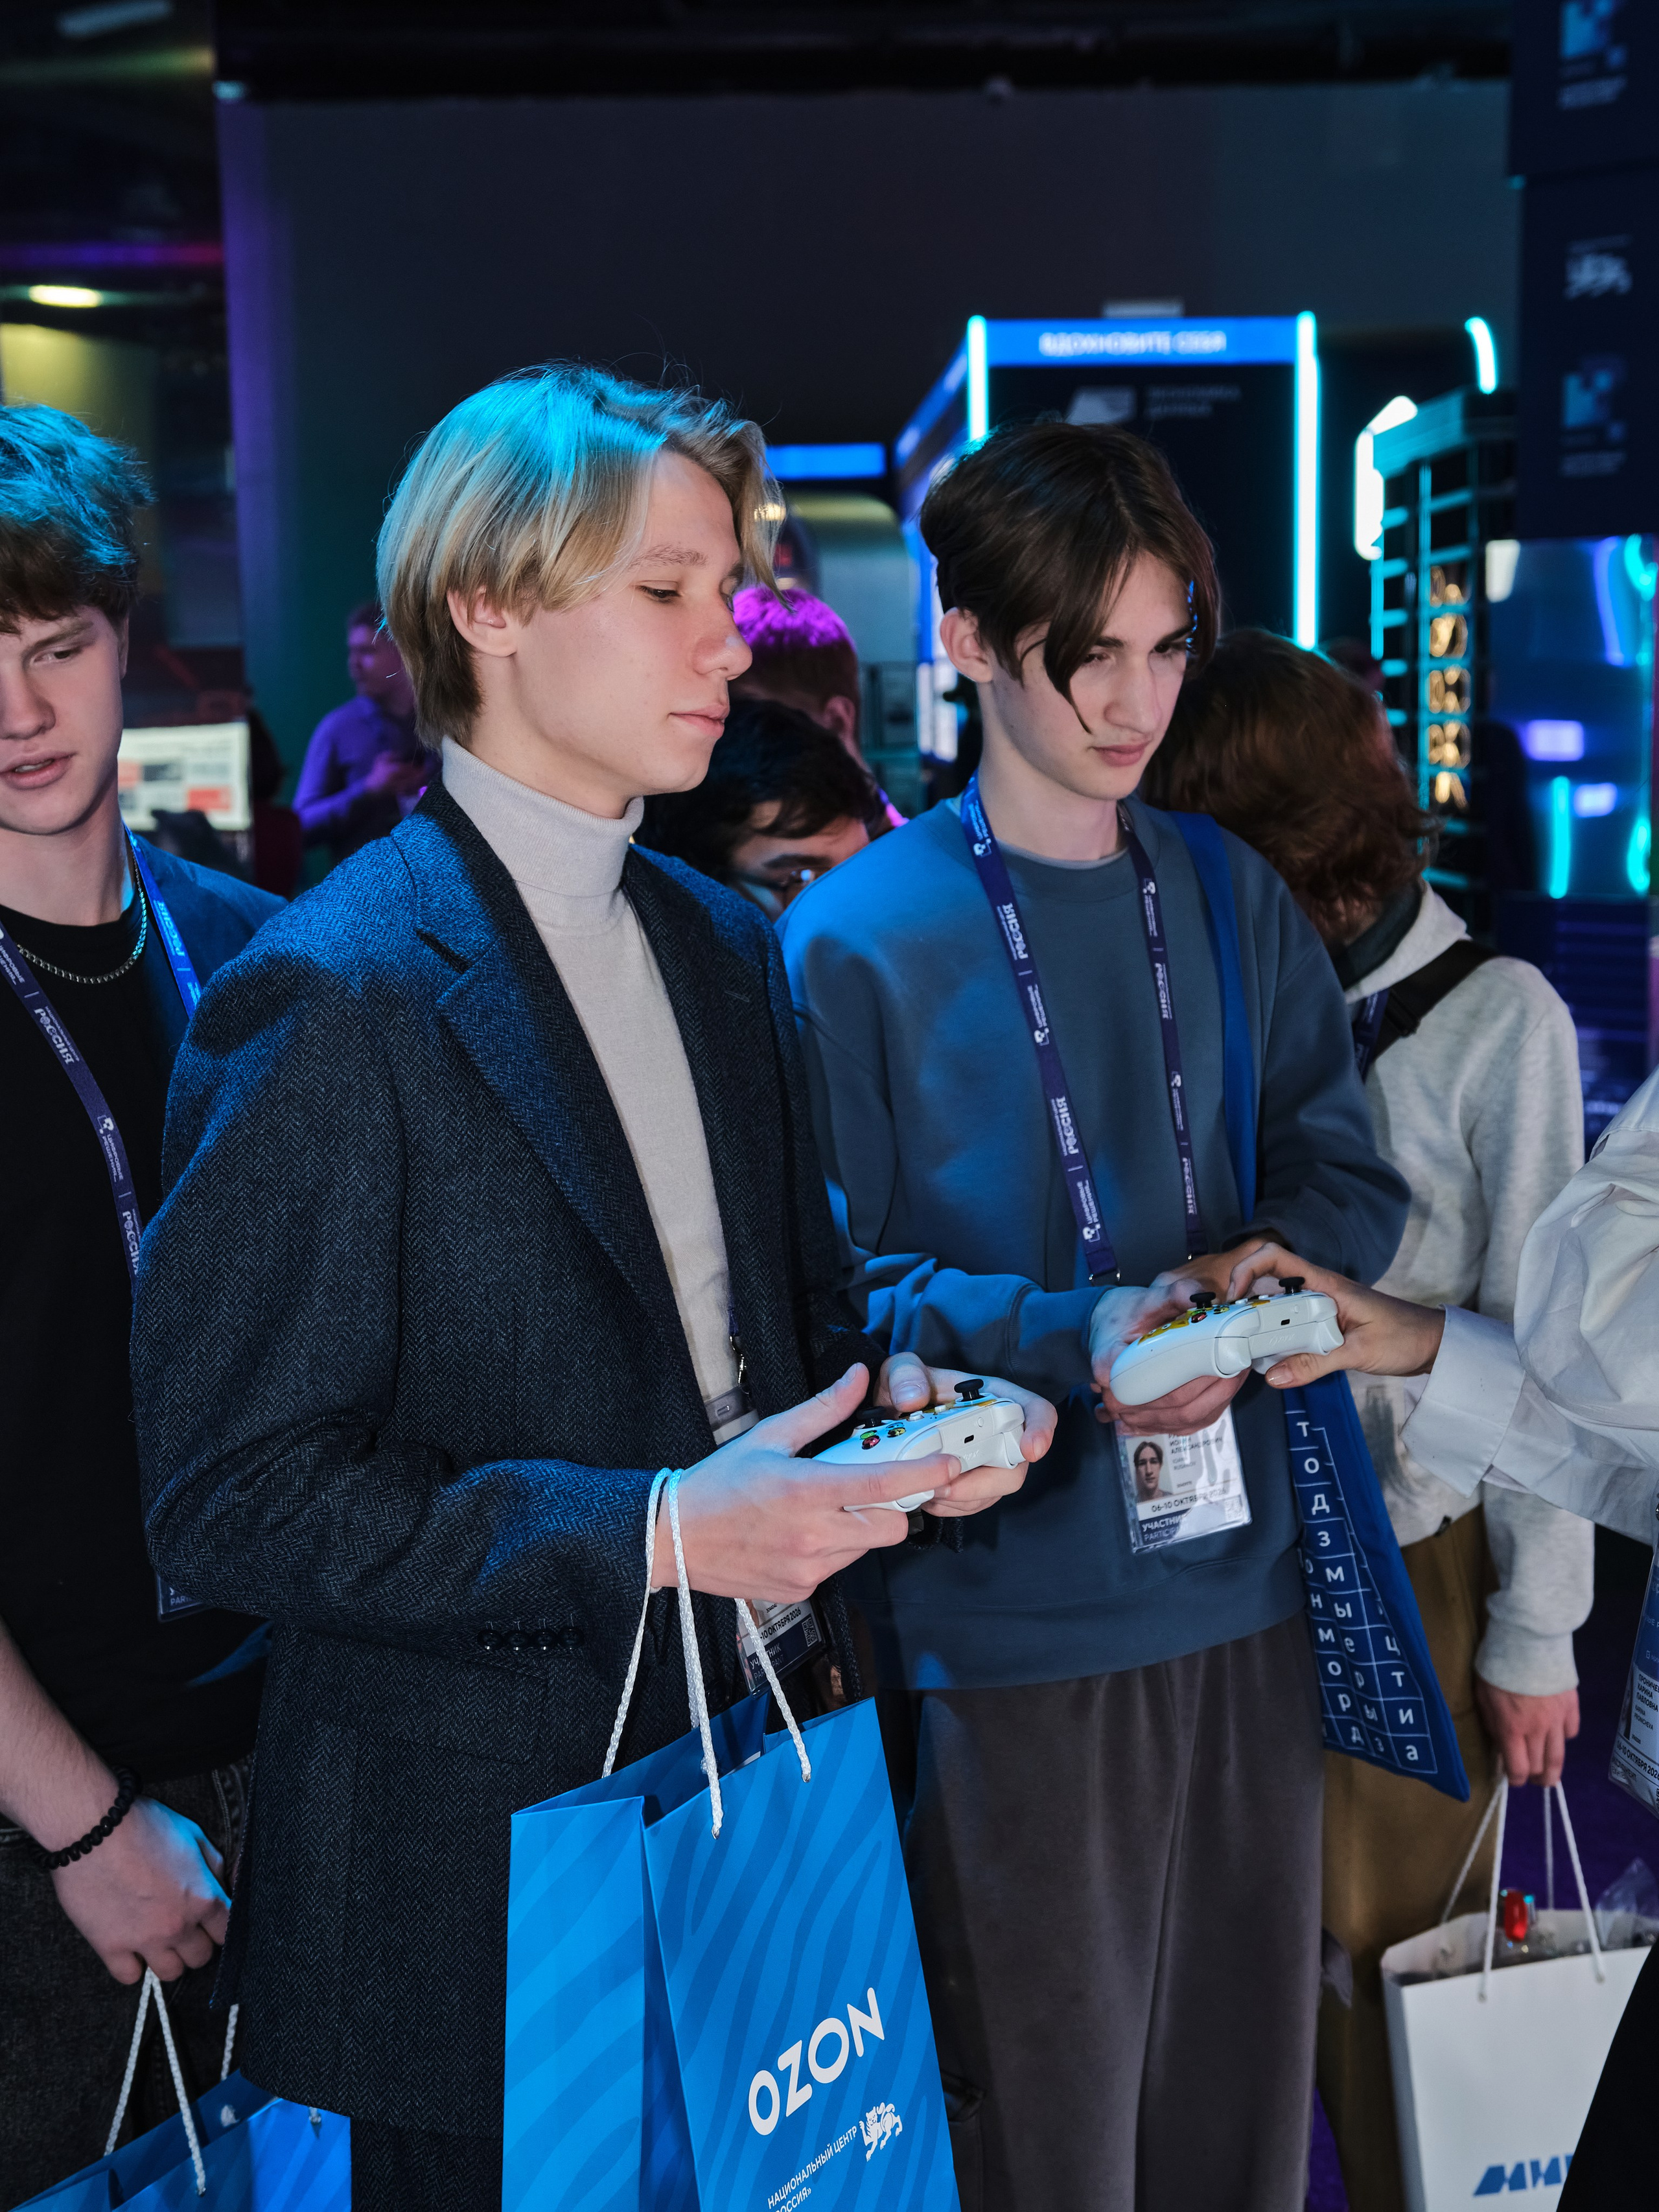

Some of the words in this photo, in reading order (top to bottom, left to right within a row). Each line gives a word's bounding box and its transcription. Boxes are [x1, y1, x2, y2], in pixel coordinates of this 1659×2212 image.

[1002, 903, 1028, 959] РОССИЯ
[0, 945, 25, 983] ИФРОВЫЕ
[34, 1008, 74, 1064] РОССИЯ
[1056, 1096, 1079, 1154] РОССИЯ
[107, 1134, 123, 1180] ЦИФРОВЫЕ
[1142, 1514, 1183, 1532] УЧАСТНИ
[760, 1629, 768, 1640] -10
[768, 1613, 791, 1635] ОКТЯБРЯ
[790, 1607, 802, 1621] 2026
[750, 1643, 782, 1670] УЧНИК
[754, 1655, 783, 1681] PARPANT
[1636, 1692, 1658, 1712] ПАВЛОВНА
[1638, 1682, 1653, 1699] КАРИНА
[1634, 1712, 1653, 1730] PRONICHEVA
[1627, 1749, 1647, 1772] ОКТЯБРЯ
[748, 1987, 885, 2136] OZON
[767, 2143, 834, 2209] НАЦИОНАЛЬНЫЙ
[833, 2126, 858, 2155] ЦЕНТР
[776, 2186, 812, 2212] ОССИЯ»
